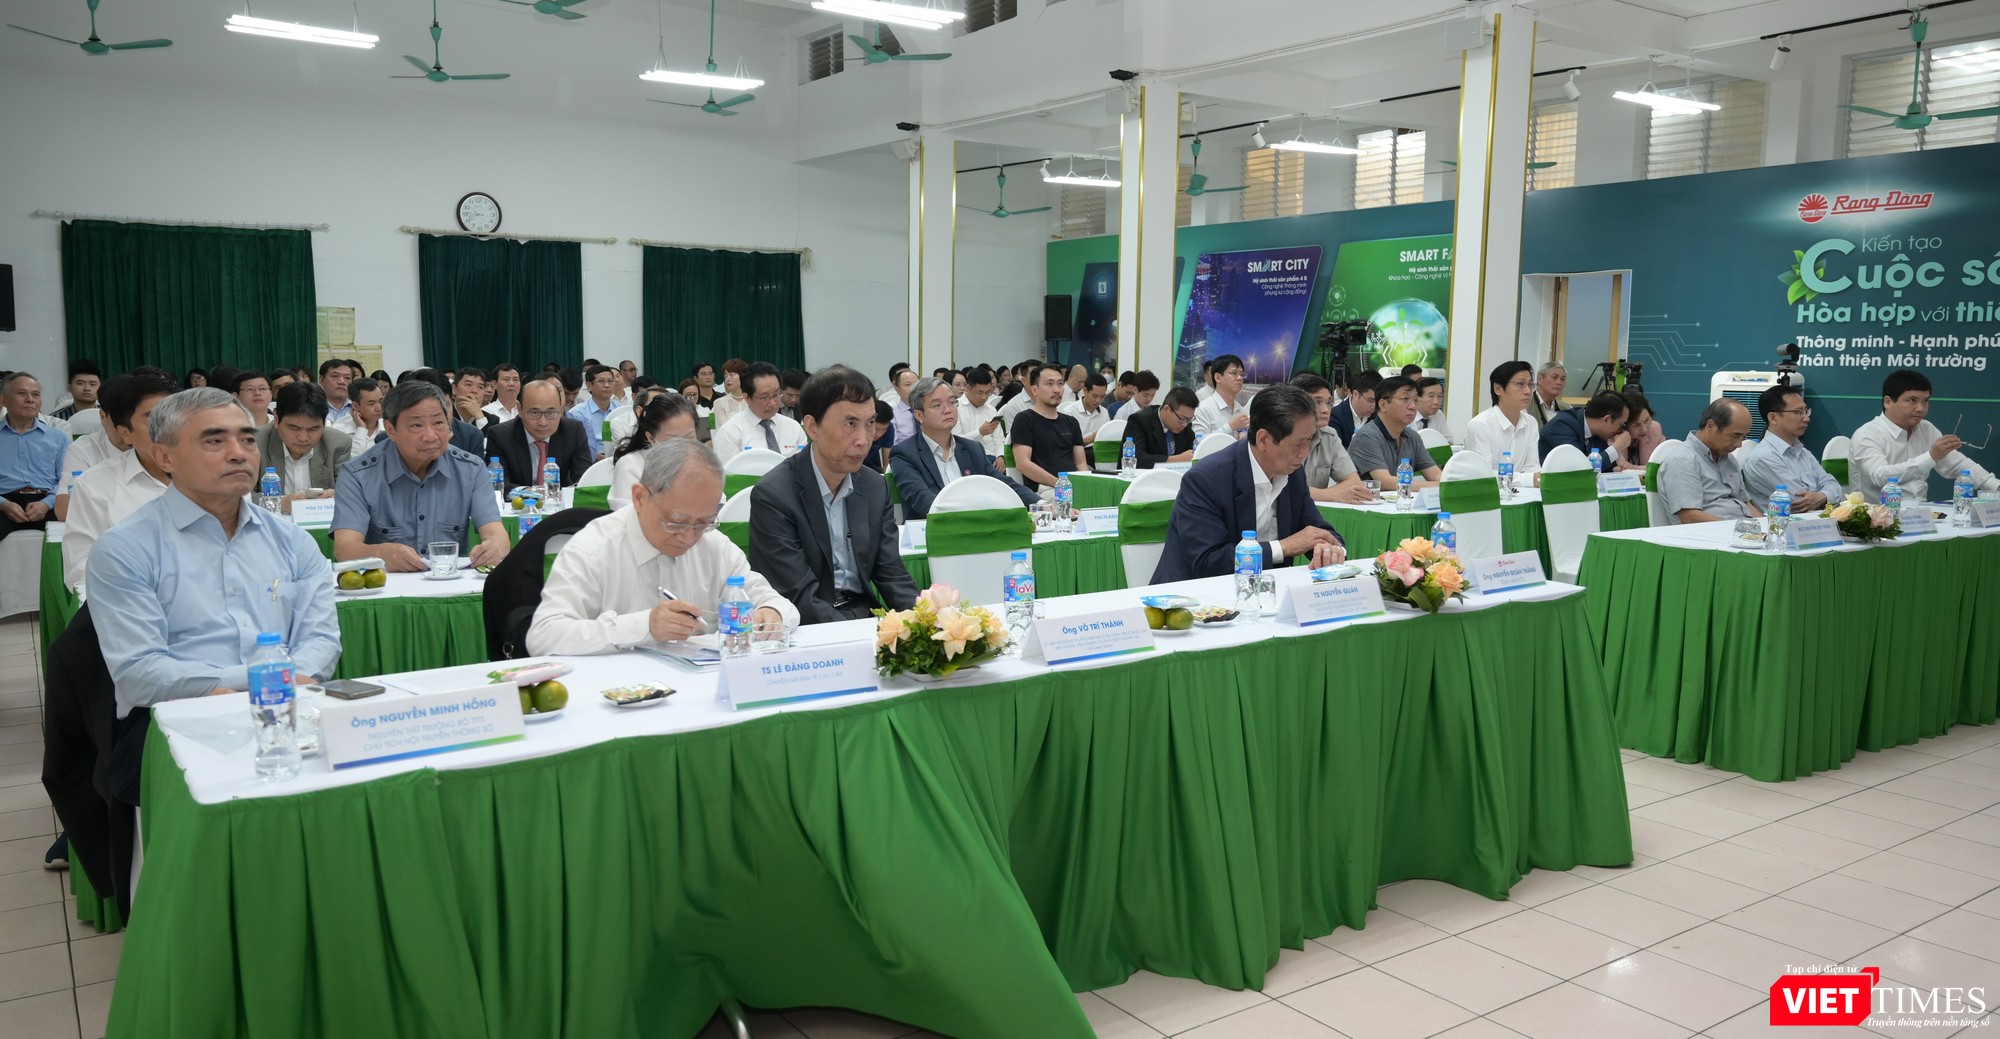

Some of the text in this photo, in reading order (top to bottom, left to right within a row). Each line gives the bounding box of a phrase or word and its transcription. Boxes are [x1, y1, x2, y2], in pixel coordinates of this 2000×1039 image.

[1862, 235, 1943, 253] Kiến tạo
[1399, 249, 1439, 262] SMART
[1247, 258, 1310, 273] SMART CITY
[1800, 238, 1946, 298] Cuộc
[1797, 301, 2000, 327] Hòa hợp với thi
[1796, 334, 1847, 351] Thông
[1851, 335, 1894, 348] minh
[1910, 334, 1959, 351] Hạnh
[1839, 353, 1882, 369] thiện
[1887, 353, 1920, 367] Môi
[1925, 353, 1987, 371] trường
[1320, 586, 1342, 597] NGUYỄN
[1062, 626, 1077, 635] Ông
[1090, 620, 1100, 630] TRÍ
[1101, 618, 1124, 629] THÀNH
[761, 658, 844, 675] TS LÊ ĐĂNG DOANH
[351, 697, 497, 728] Ông NGUYỄN MINH HỒNG
